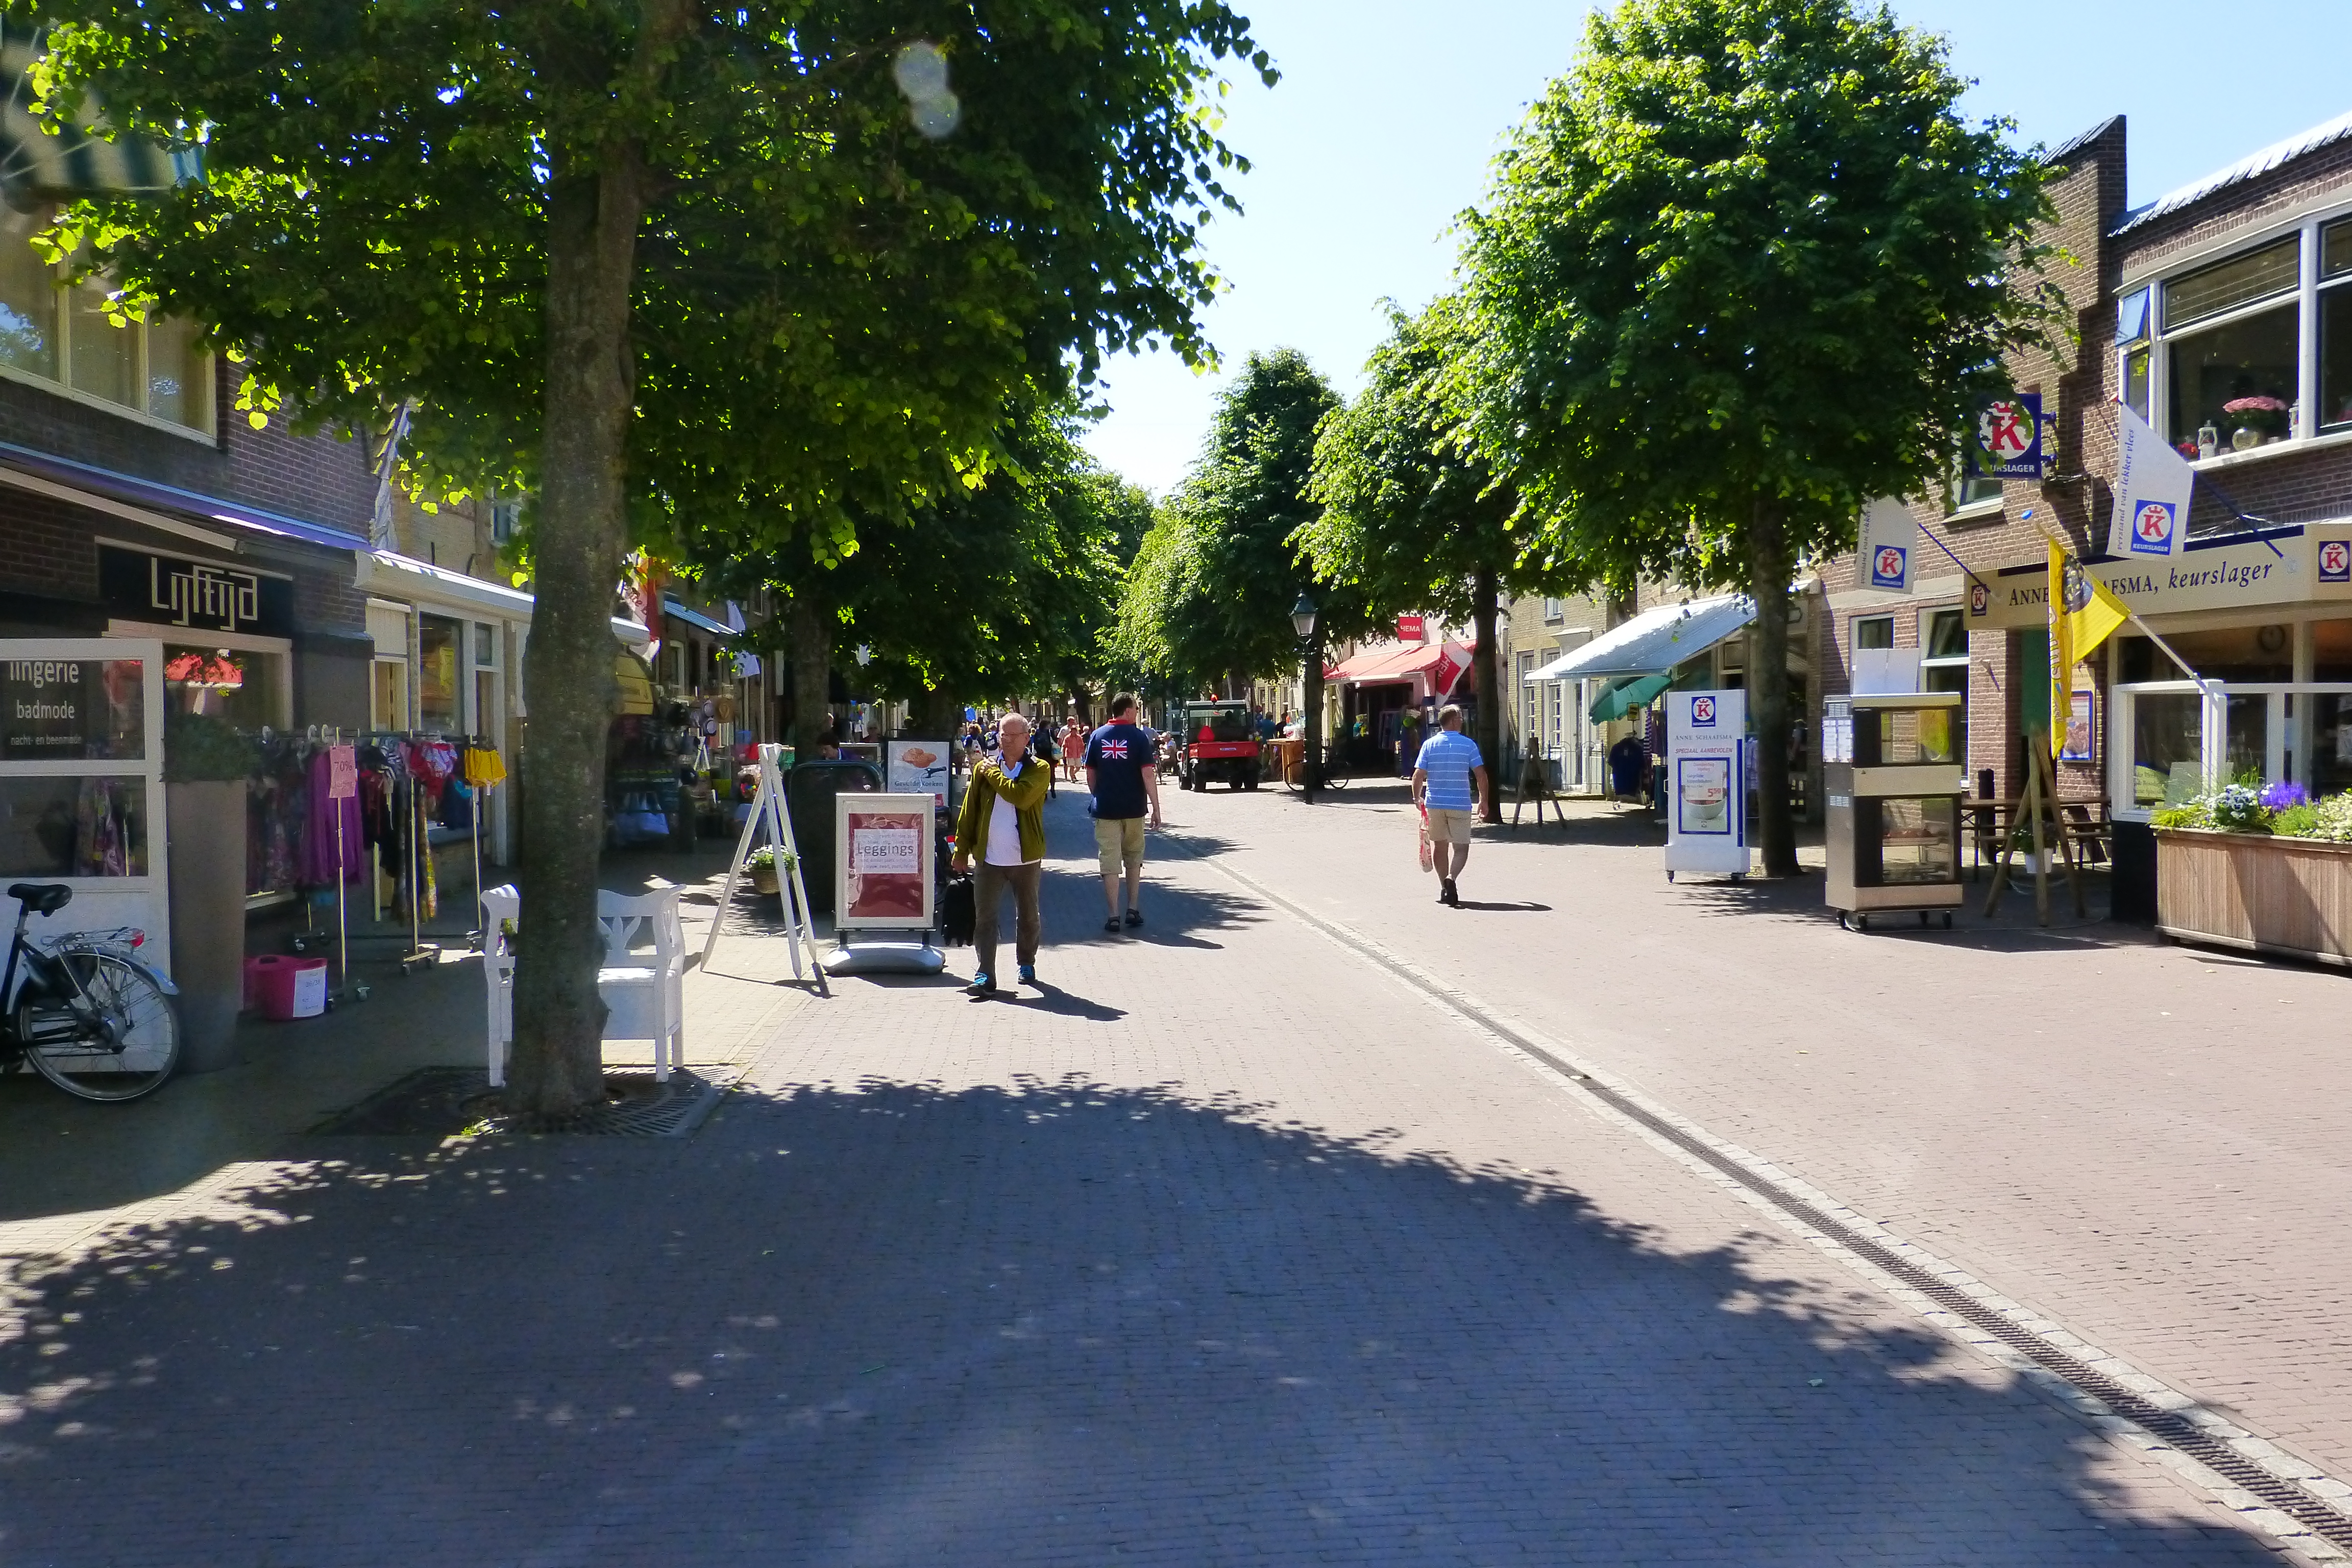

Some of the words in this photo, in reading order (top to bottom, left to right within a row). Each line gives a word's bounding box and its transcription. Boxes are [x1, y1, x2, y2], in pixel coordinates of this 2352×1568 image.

[2124, 429, 2134, 451] vlees
[2121, 455, 2132, 485] lekker
[2168, 561, 2272, 589] keurslager
[10, 662, 79, 688] lingerie
[17, 699, 75, 719] badmode
[35, 737, 44, 745] en
[334, 761, 352, 772] 70%
[857, 843, 914, 856] Leggings
